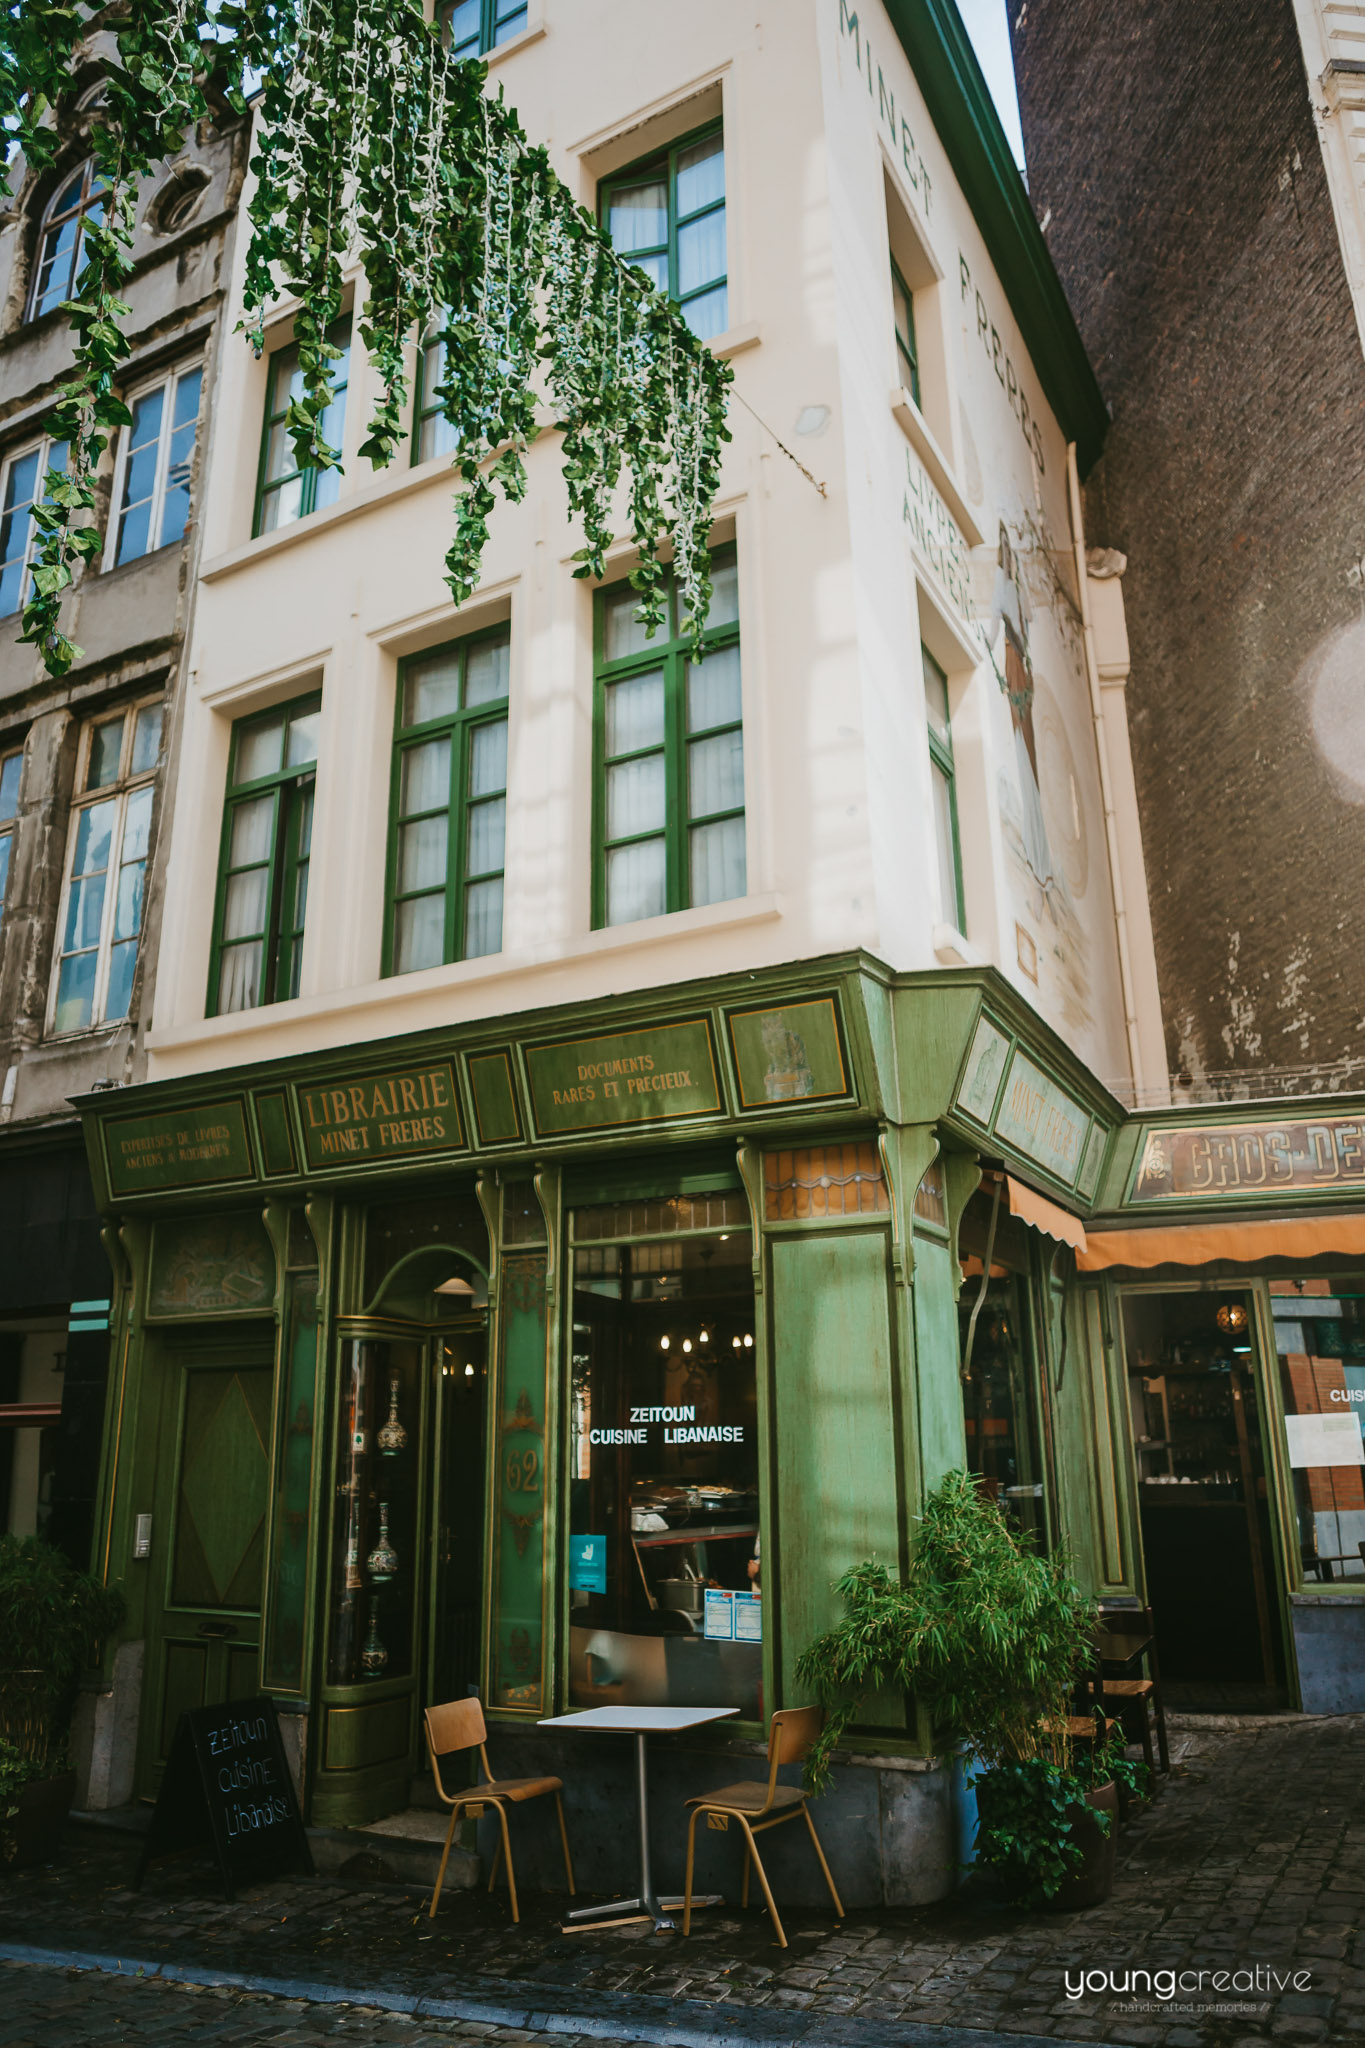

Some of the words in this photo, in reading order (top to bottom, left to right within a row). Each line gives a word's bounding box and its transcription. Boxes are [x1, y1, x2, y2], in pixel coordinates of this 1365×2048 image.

[839, 0, 932, 217] MINET
[959, 248, 1045, 476] FRERES
[906, 446, 970, 584] LIVRES
[577, 1055, 655, 1081] DOCUMENTS
[305, 1072, 449, 1127] LIBRAIRIE
[553, 1085, 596, 1105] RARES
[604, 1081, 619, 1098] ET
[195, 1126, 230, 1142] LIVRES
[320, 1127, 369, 1154] MINET
[379, 1116, 446, 1146] FRERES
[1012, 1079, 1045, 1137] MINET
[1043, 1105, 1082, 1165] FRERES
[1330, 1389, 1365, 1402] CUIS
[630, 1406, 695, 1423] ZEITOUN
[590, 1429, 647, 1444] CUISINE
[664, 1426, 744, 1444] LIBANAISE
[507, 1450, 538, 1491] 62
